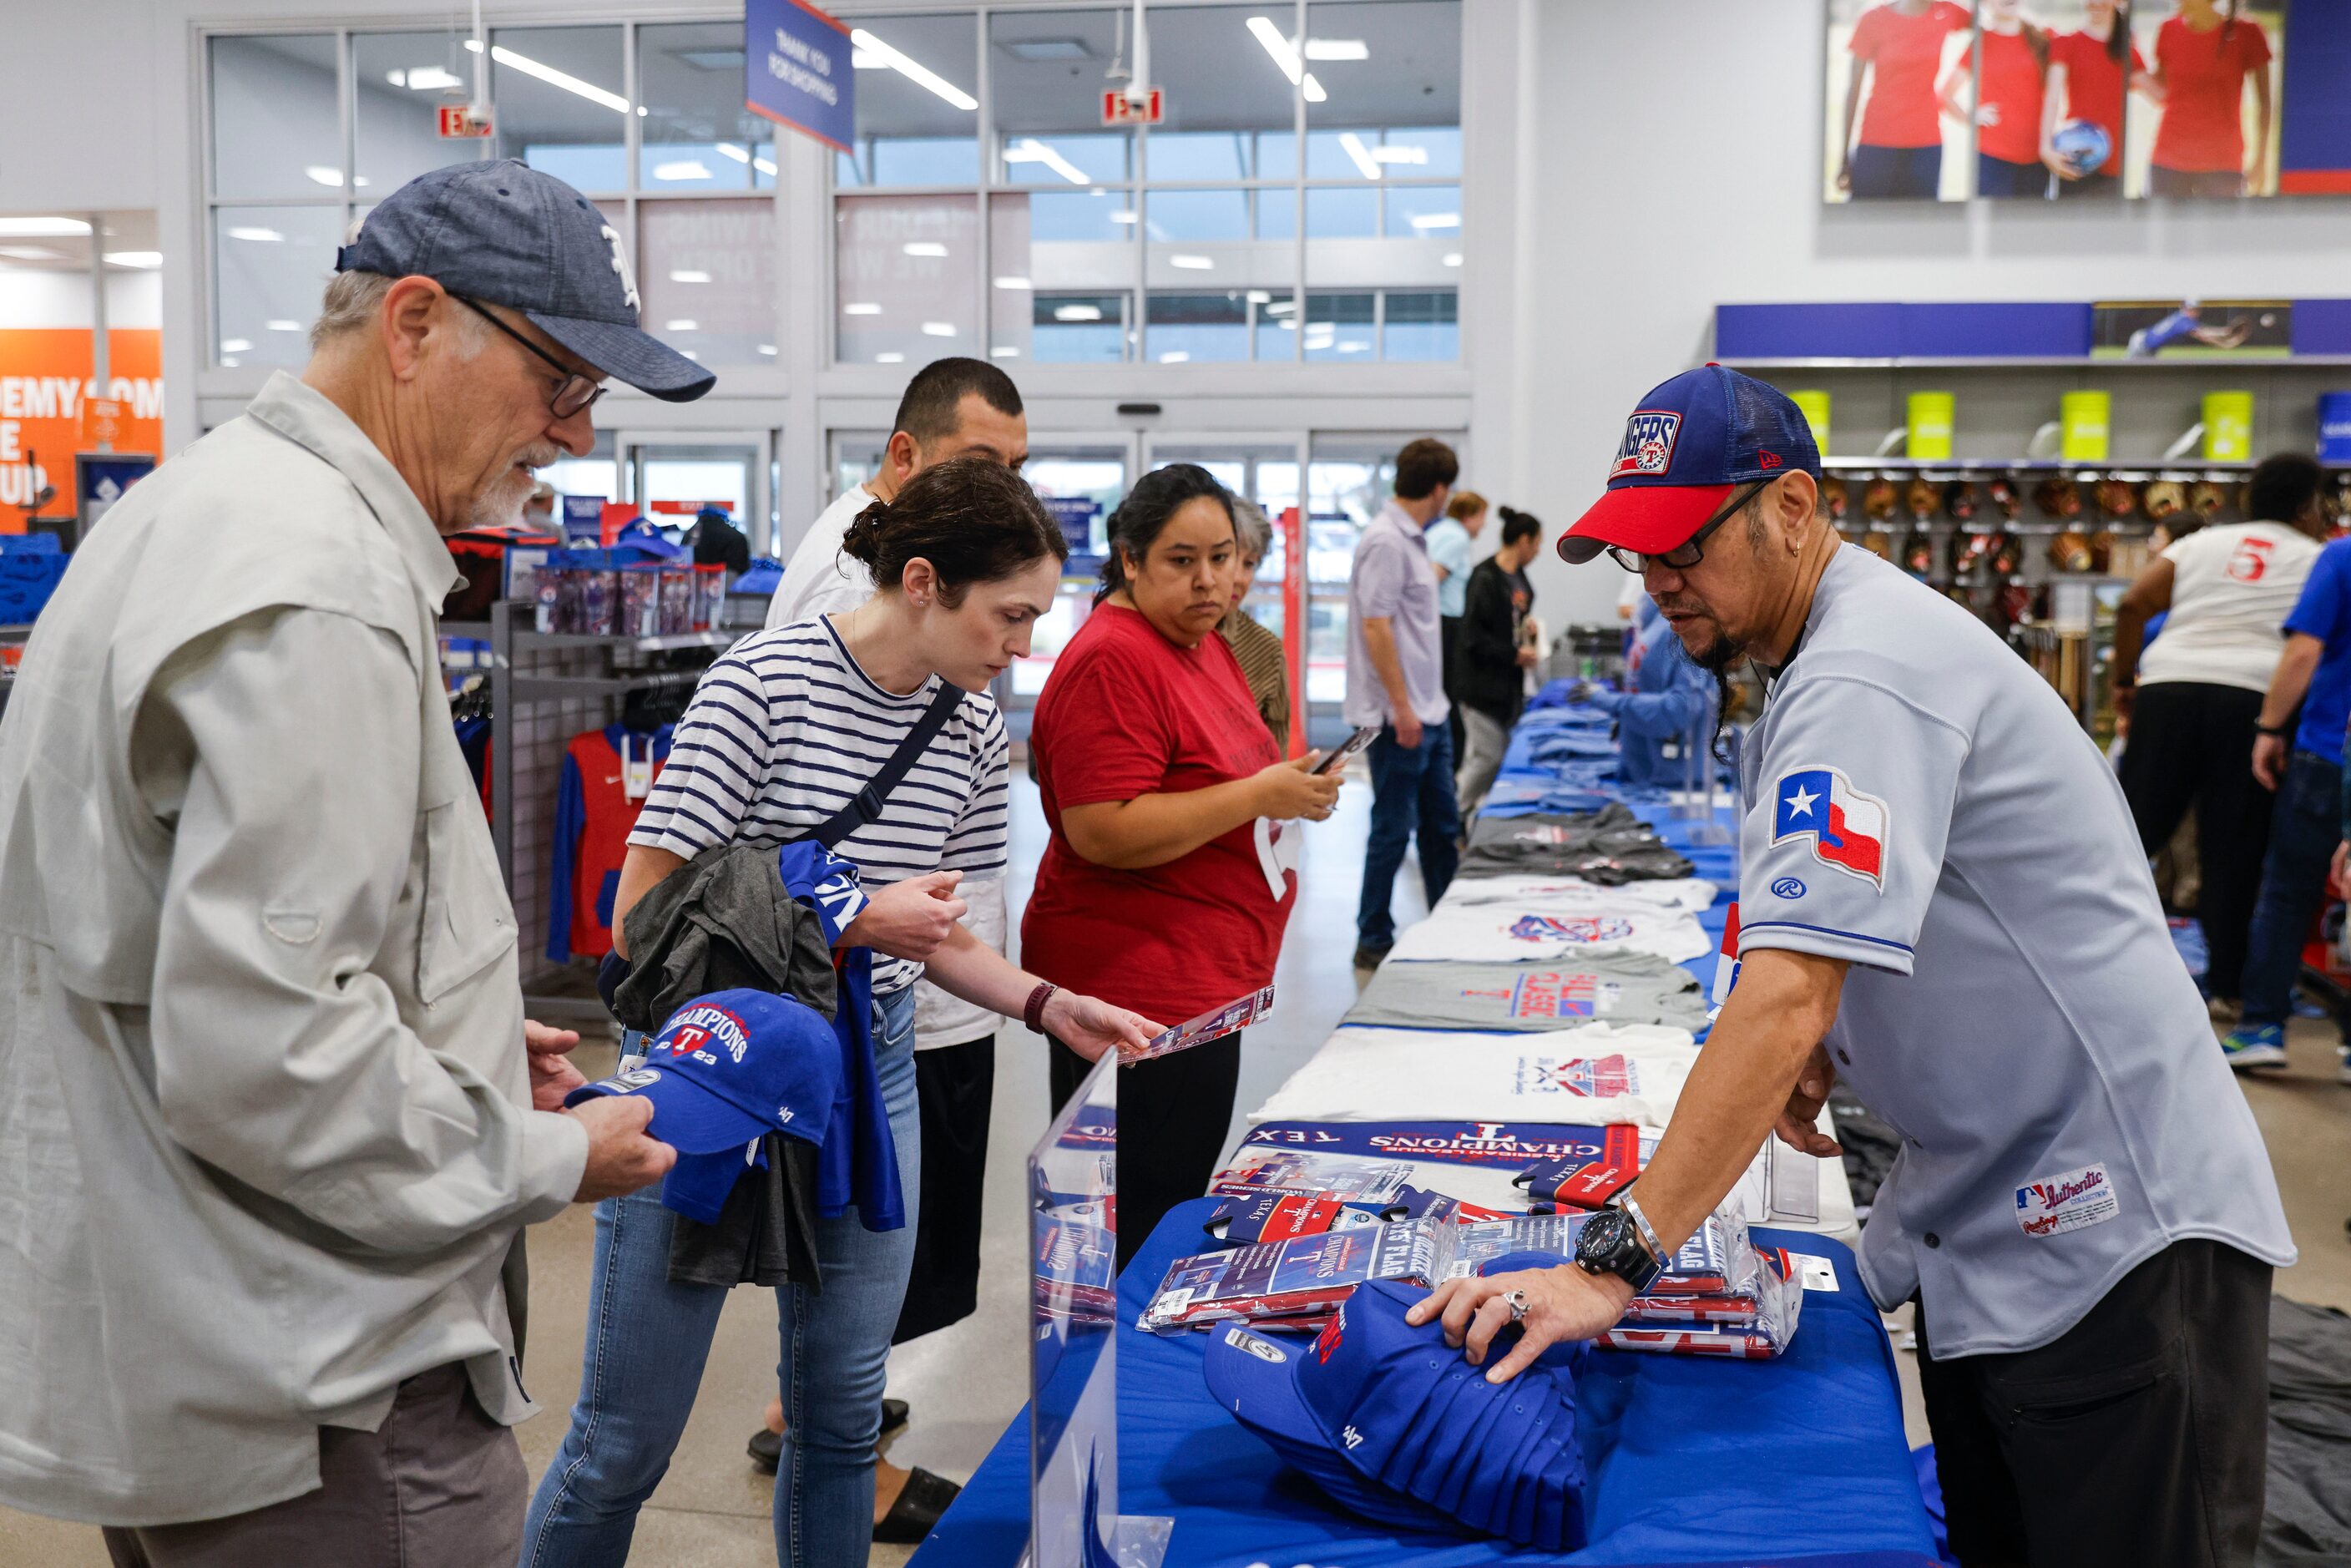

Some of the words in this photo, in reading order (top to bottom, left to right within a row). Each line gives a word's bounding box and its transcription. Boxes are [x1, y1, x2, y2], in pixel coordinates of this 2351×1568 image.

[2227, 537, 2274, 582] 5
[675, 1026, 704, 1052] T
[692, 1050, 718, 1066] 23
[1369, 1136, 1604, 1156] CHAMPIONS
[1549, 1163, 1580, 1182] TEXAS
[1581, 1168, 1620, 1193] CHAMPIONS
[1221, 1184, 1262, 1193] SERIES
[2045, 1171, 2103, 1210] Authentic
[1248, 1198, 1273, 1222] TEXAS
[1289, 1198, 1318, 1233] CHAMPIONS
[1316, 1235, 1345, 1278] CHAMPIONS
[1381, 1246, 1412, 1277] FLAG
